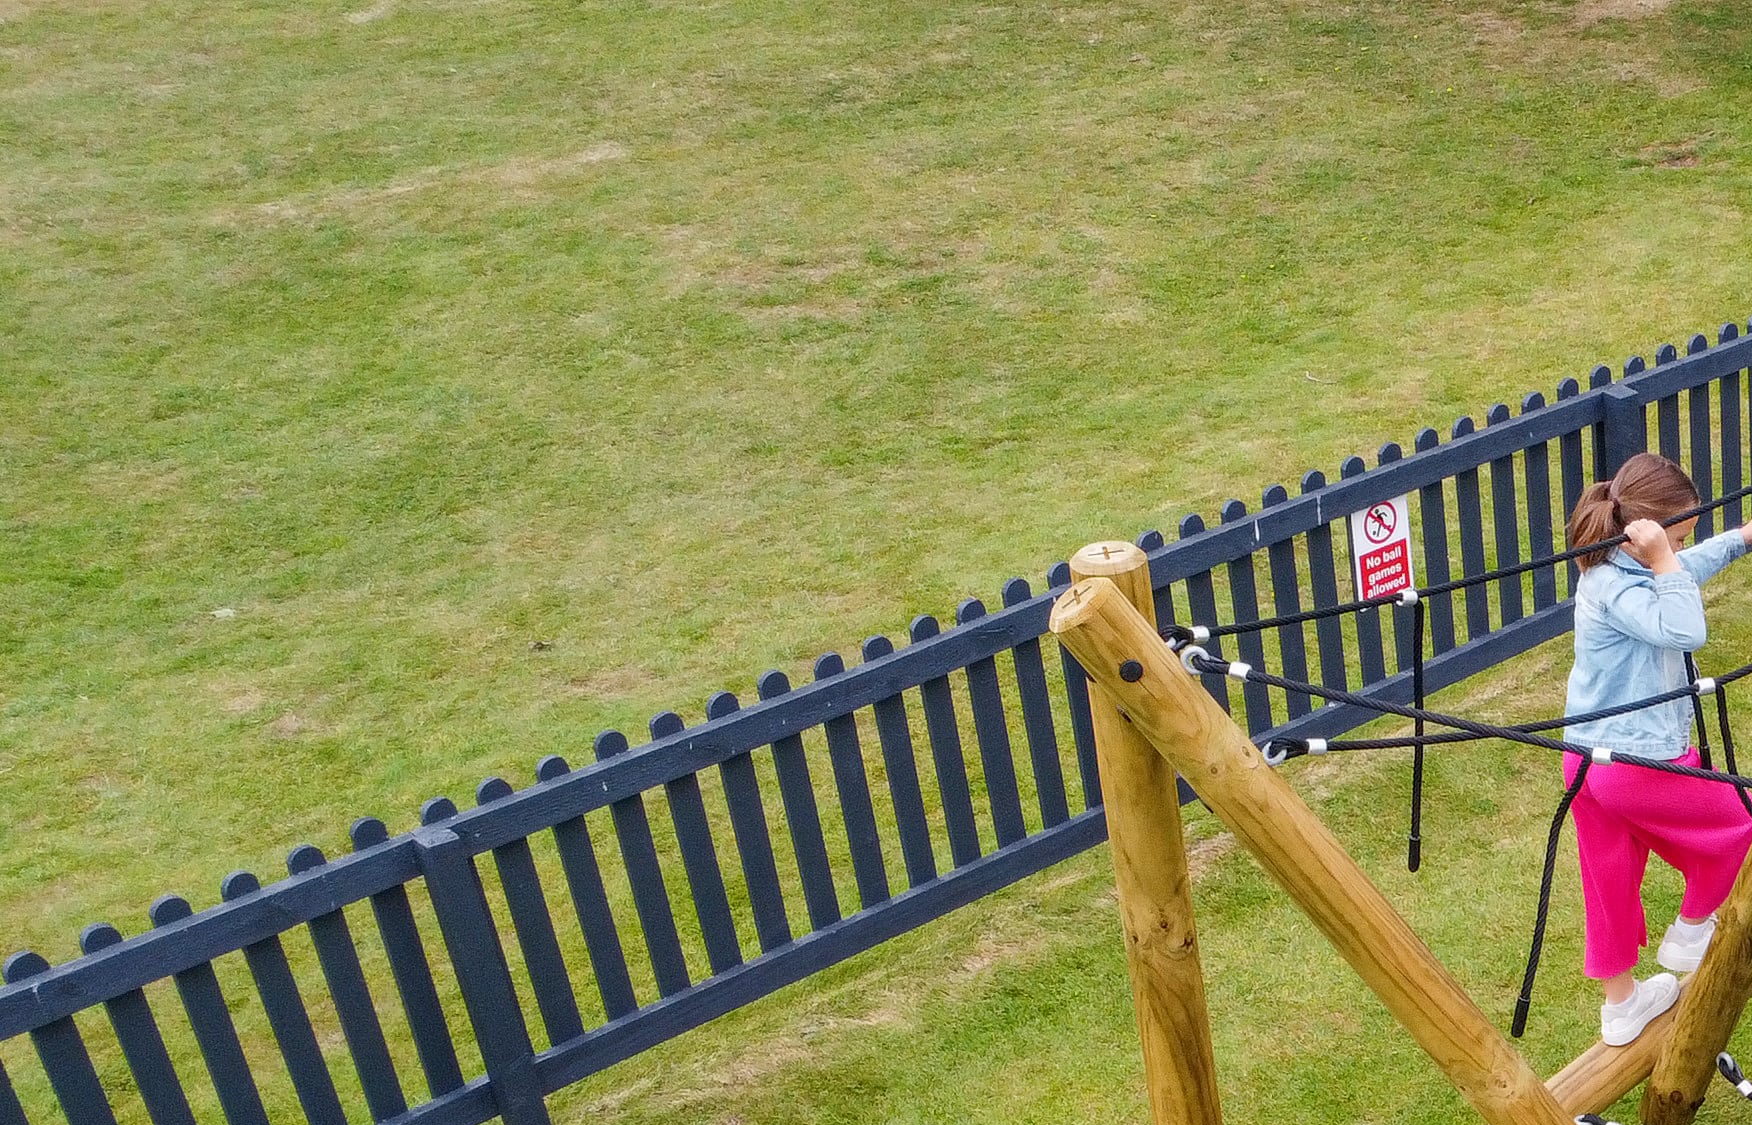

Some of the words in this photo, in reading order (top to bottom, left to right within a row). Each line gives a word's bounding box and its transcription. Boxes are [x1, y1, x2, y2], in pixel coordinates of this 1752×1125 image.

[1366, 556, 1381, 570] No
[1382, 545, 1402, 563] ball
[1367, 573, 1406, 599] allowed
[1368, 562, 1402, 586] games
